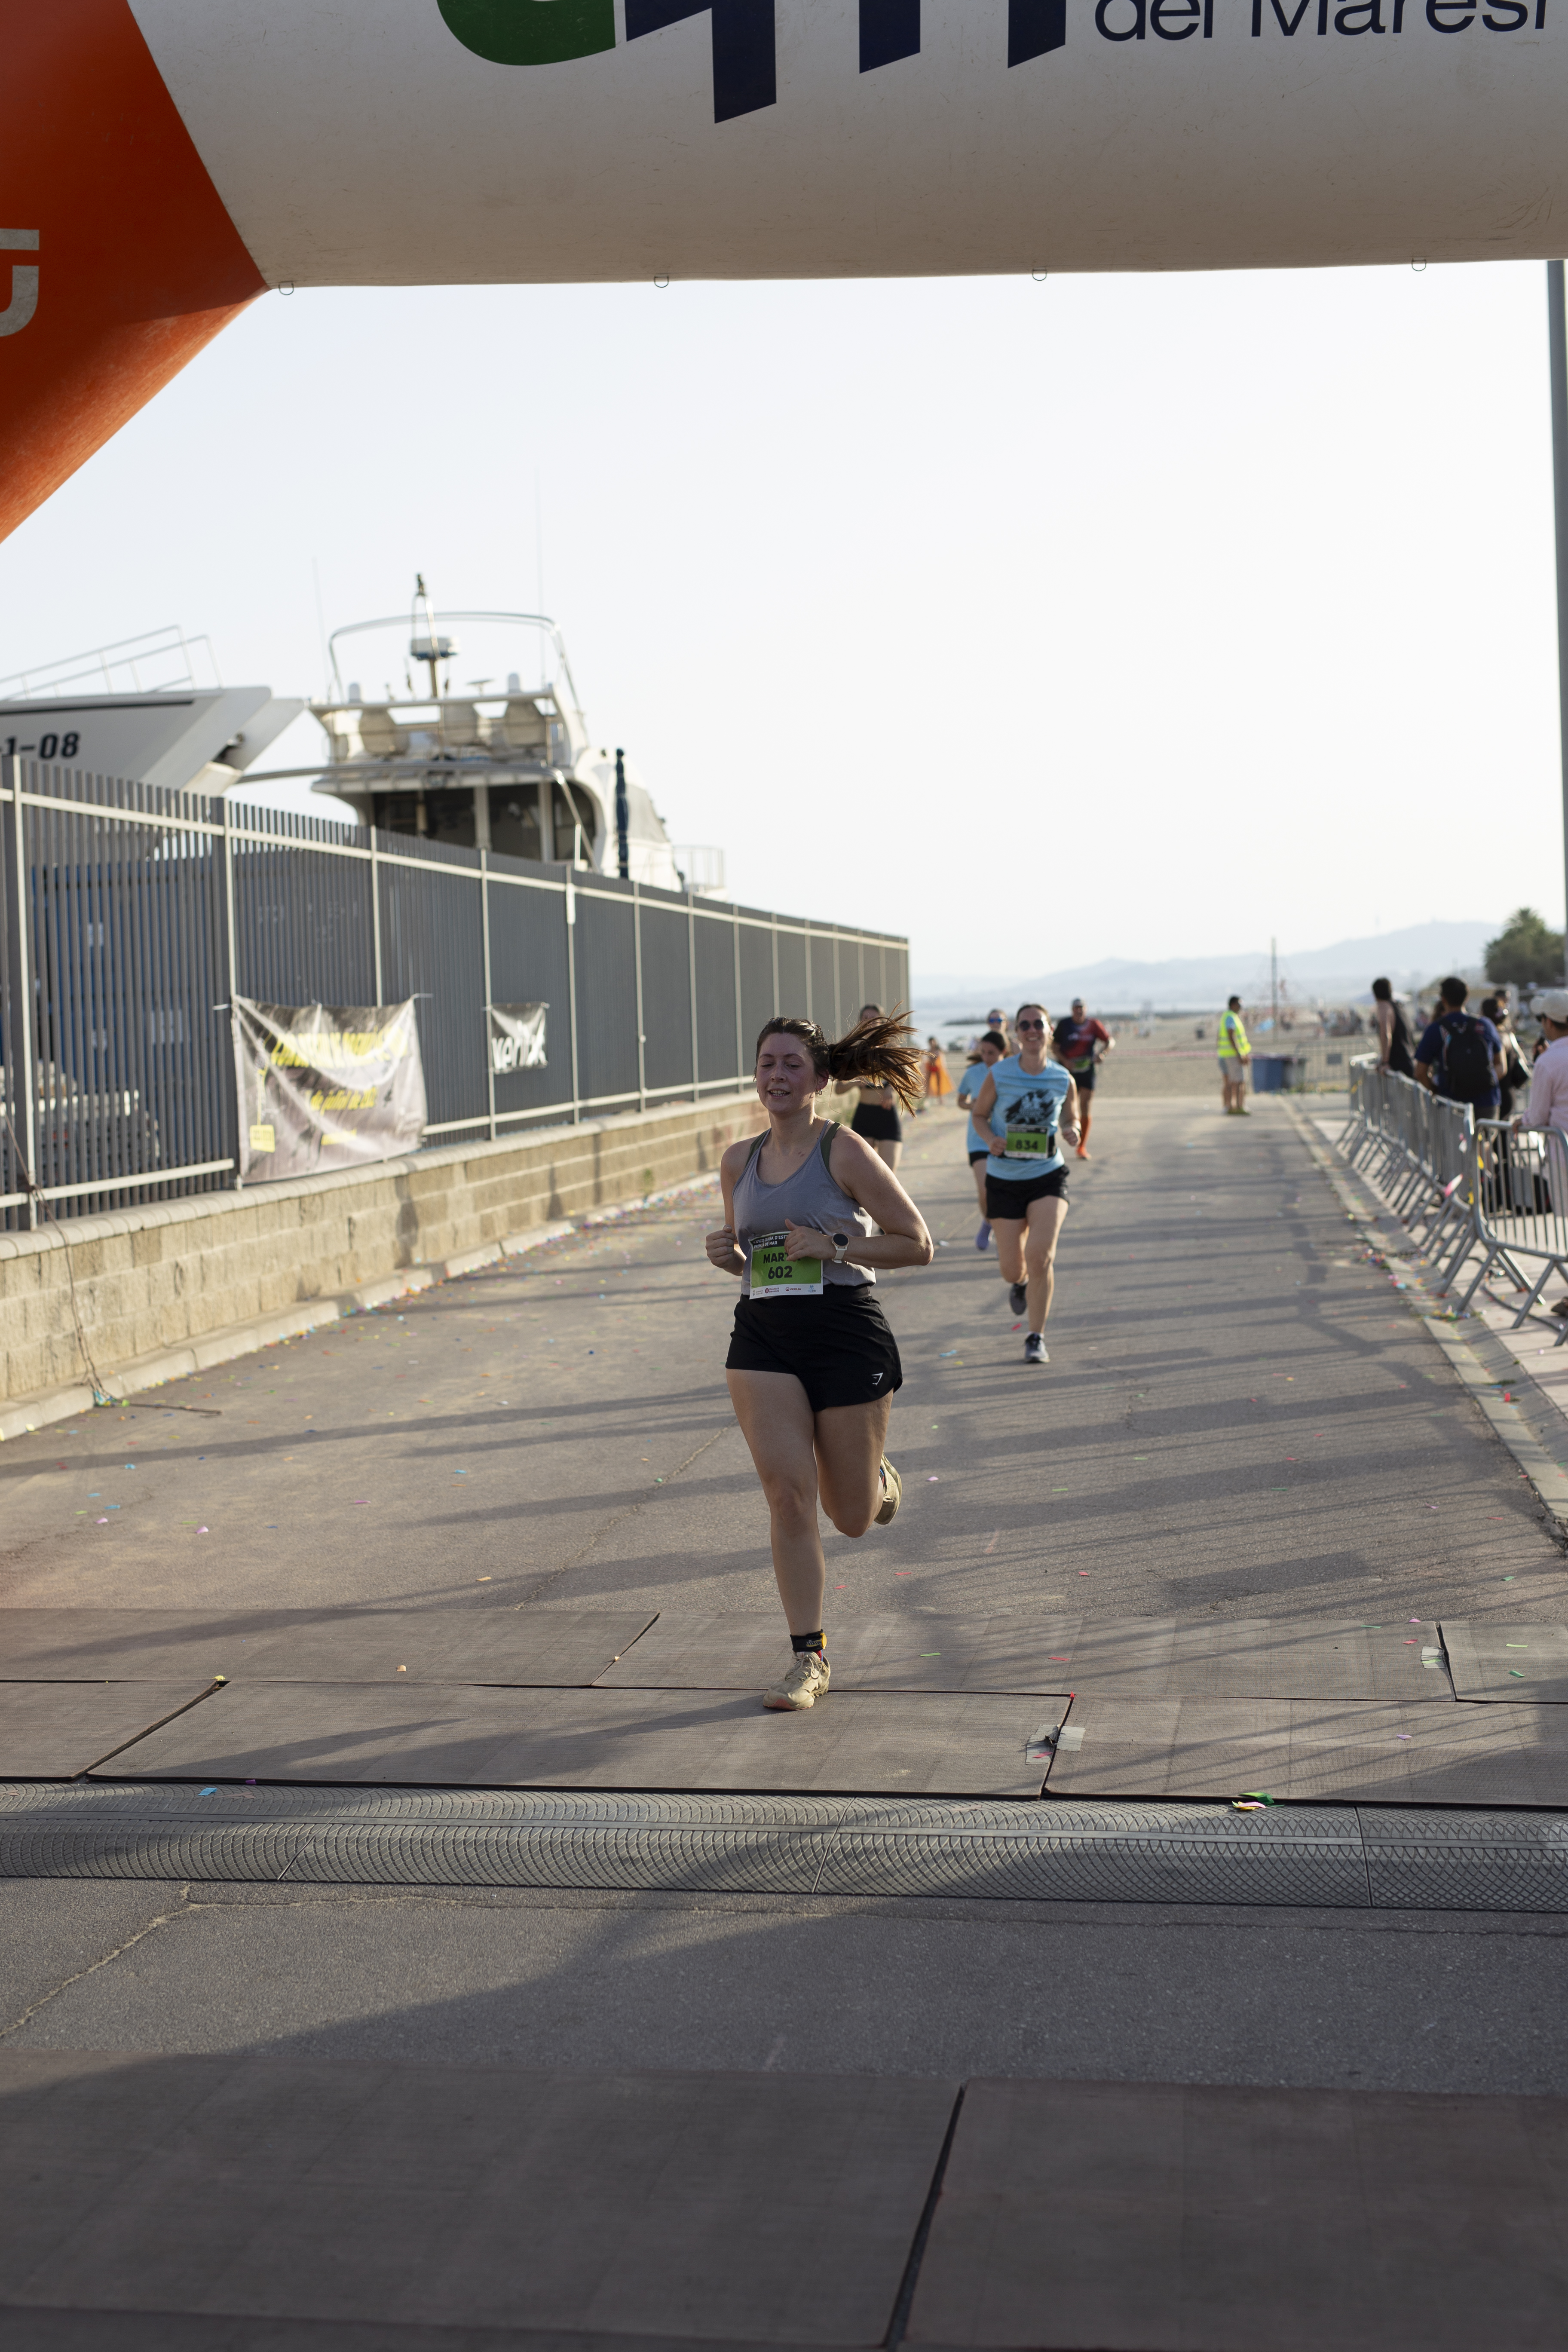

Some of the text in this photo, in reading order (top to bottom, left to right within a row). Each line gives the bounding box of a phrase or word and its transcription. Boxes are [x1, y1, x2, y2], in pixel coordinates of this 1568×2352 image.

[0, 732, 79, 759] 1-08
[1016, 1139, 1038, 1150] 834
[768, 1265, 793, 1279] 602
